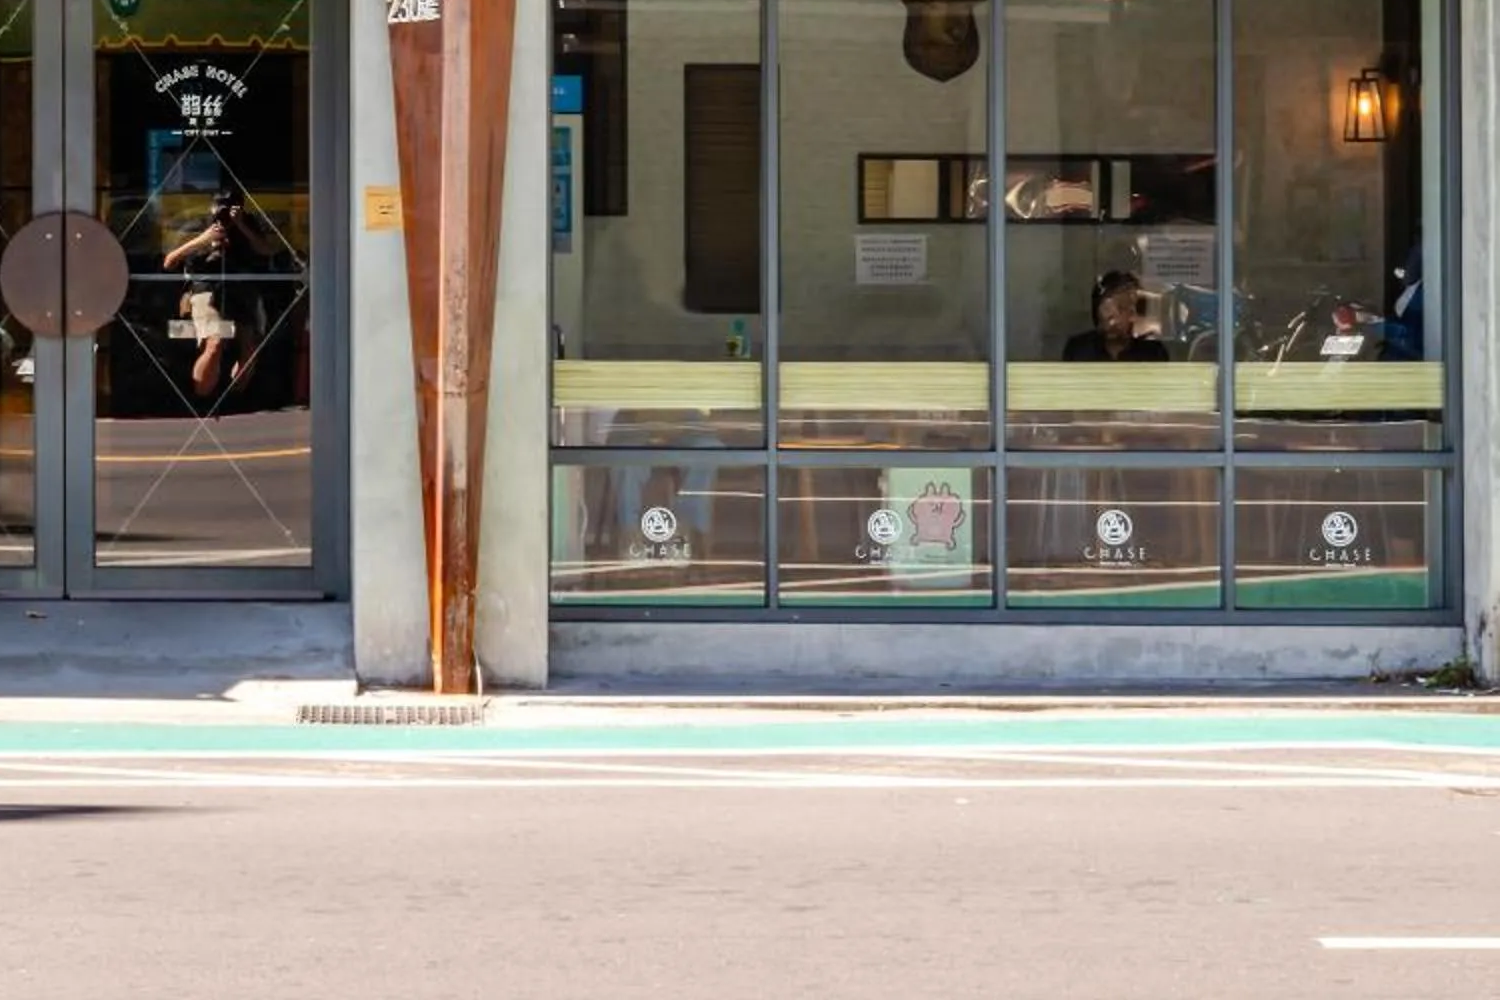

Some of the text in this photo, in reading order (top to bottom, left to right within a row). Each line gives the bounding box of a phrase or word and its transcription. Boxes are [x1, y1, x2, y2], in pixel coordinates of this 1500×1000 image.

[629, 543, 692, 559] CHASE
[1084, 547, 1146, 560] CHASE
[1309, 547, 1371, 560] CHASE
